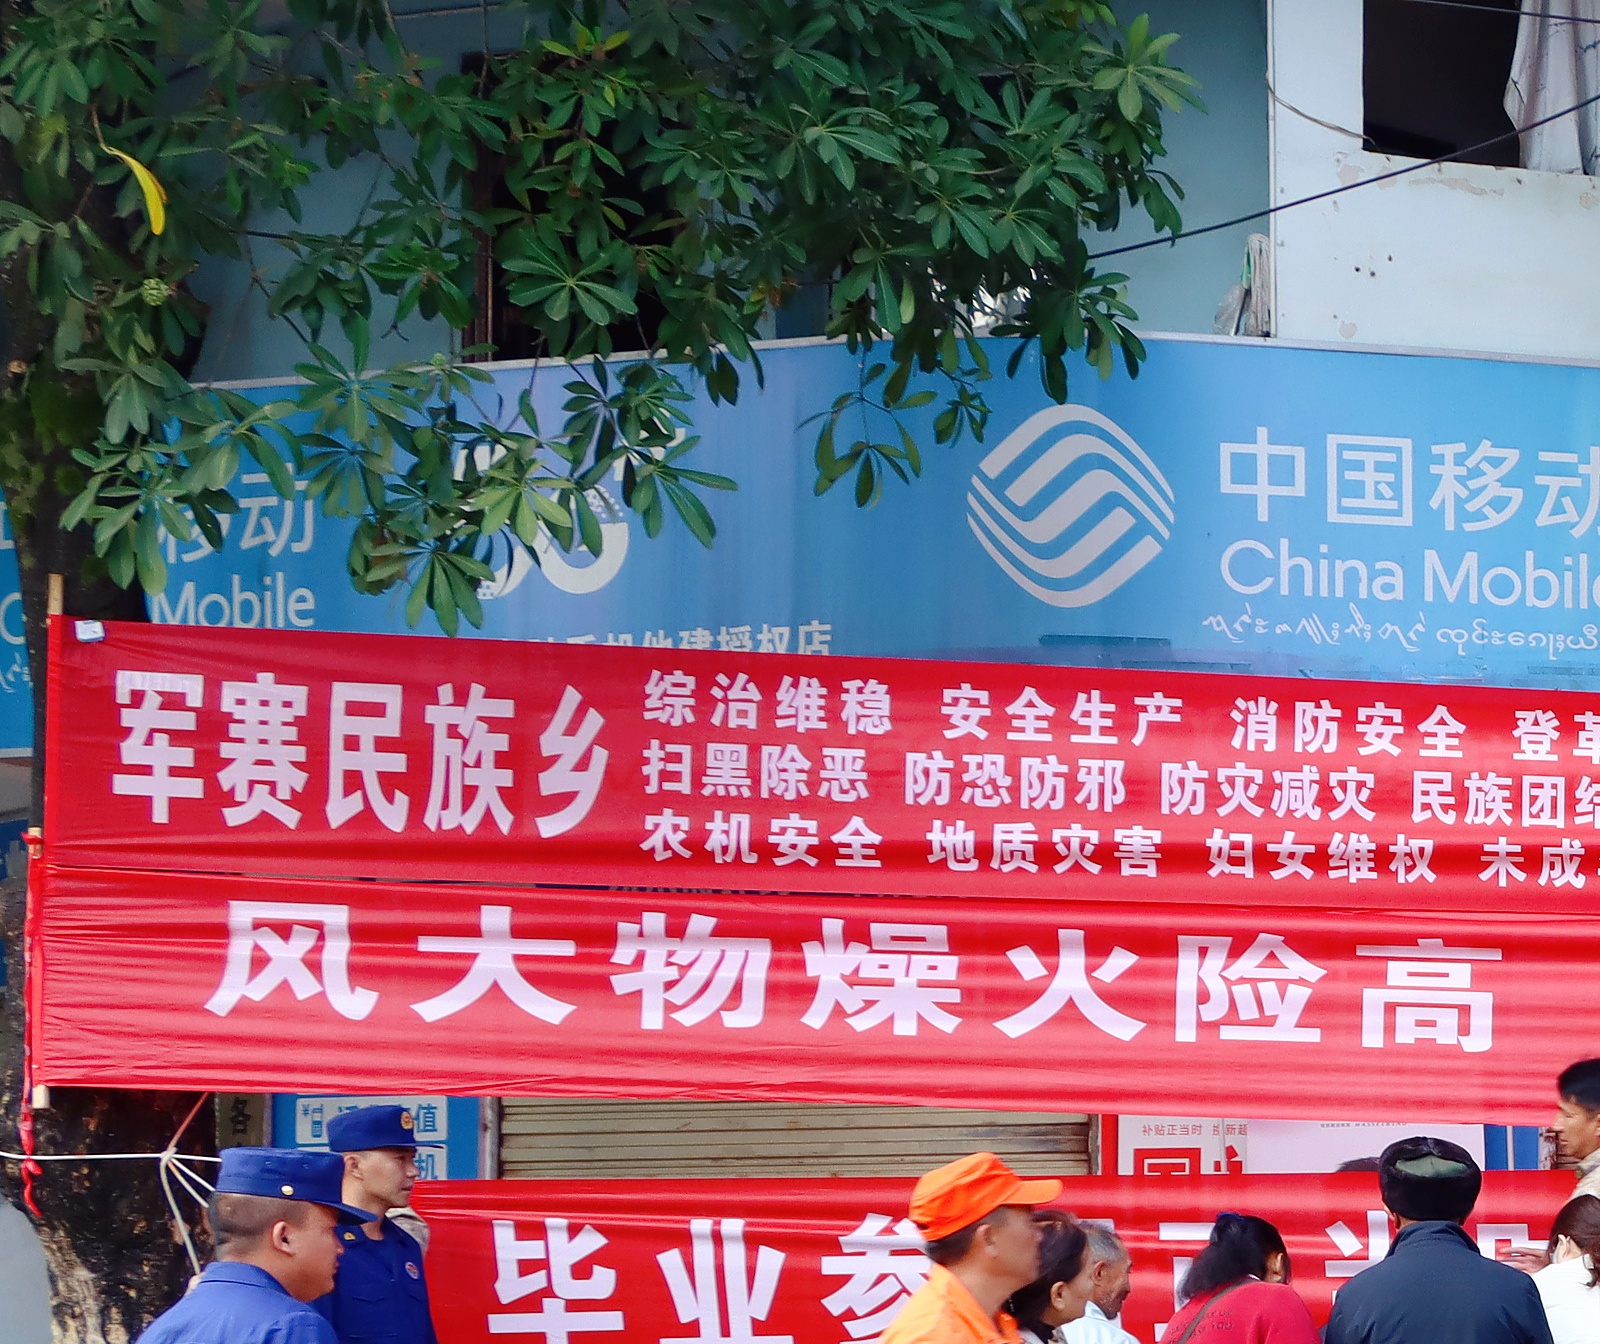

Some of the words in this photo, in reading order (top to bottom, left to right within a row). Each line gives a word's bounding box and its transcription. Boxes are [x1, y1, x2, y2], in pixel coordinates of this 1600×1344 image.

[152, 571, 315, 628] Mobile
[1220, 538, 1405, 601] China
[642, 668, 893, 736] 综治维稳
[940, 683, 1183, 747] 安全生产
[1229, 696, 1467, 758] 消防安全
[113, 670, 609, 839] 军赛民族乡
[641, 739, 870, 802] 扫黑除恶
[905, 750, 1126, 811] 防恐防邪
[1160, 759, 1377, 821] 防灾减灾
[639, 810, 883, 868] 农机安全
[925, 819, 1163, 878] 地质灾害
[1205, 827, 1437, 884] 妇女维权
[203, 900, 1503, 1053] 风大物燥火险高
[1142, 1123, 1203, 1136] 补贴正当时
